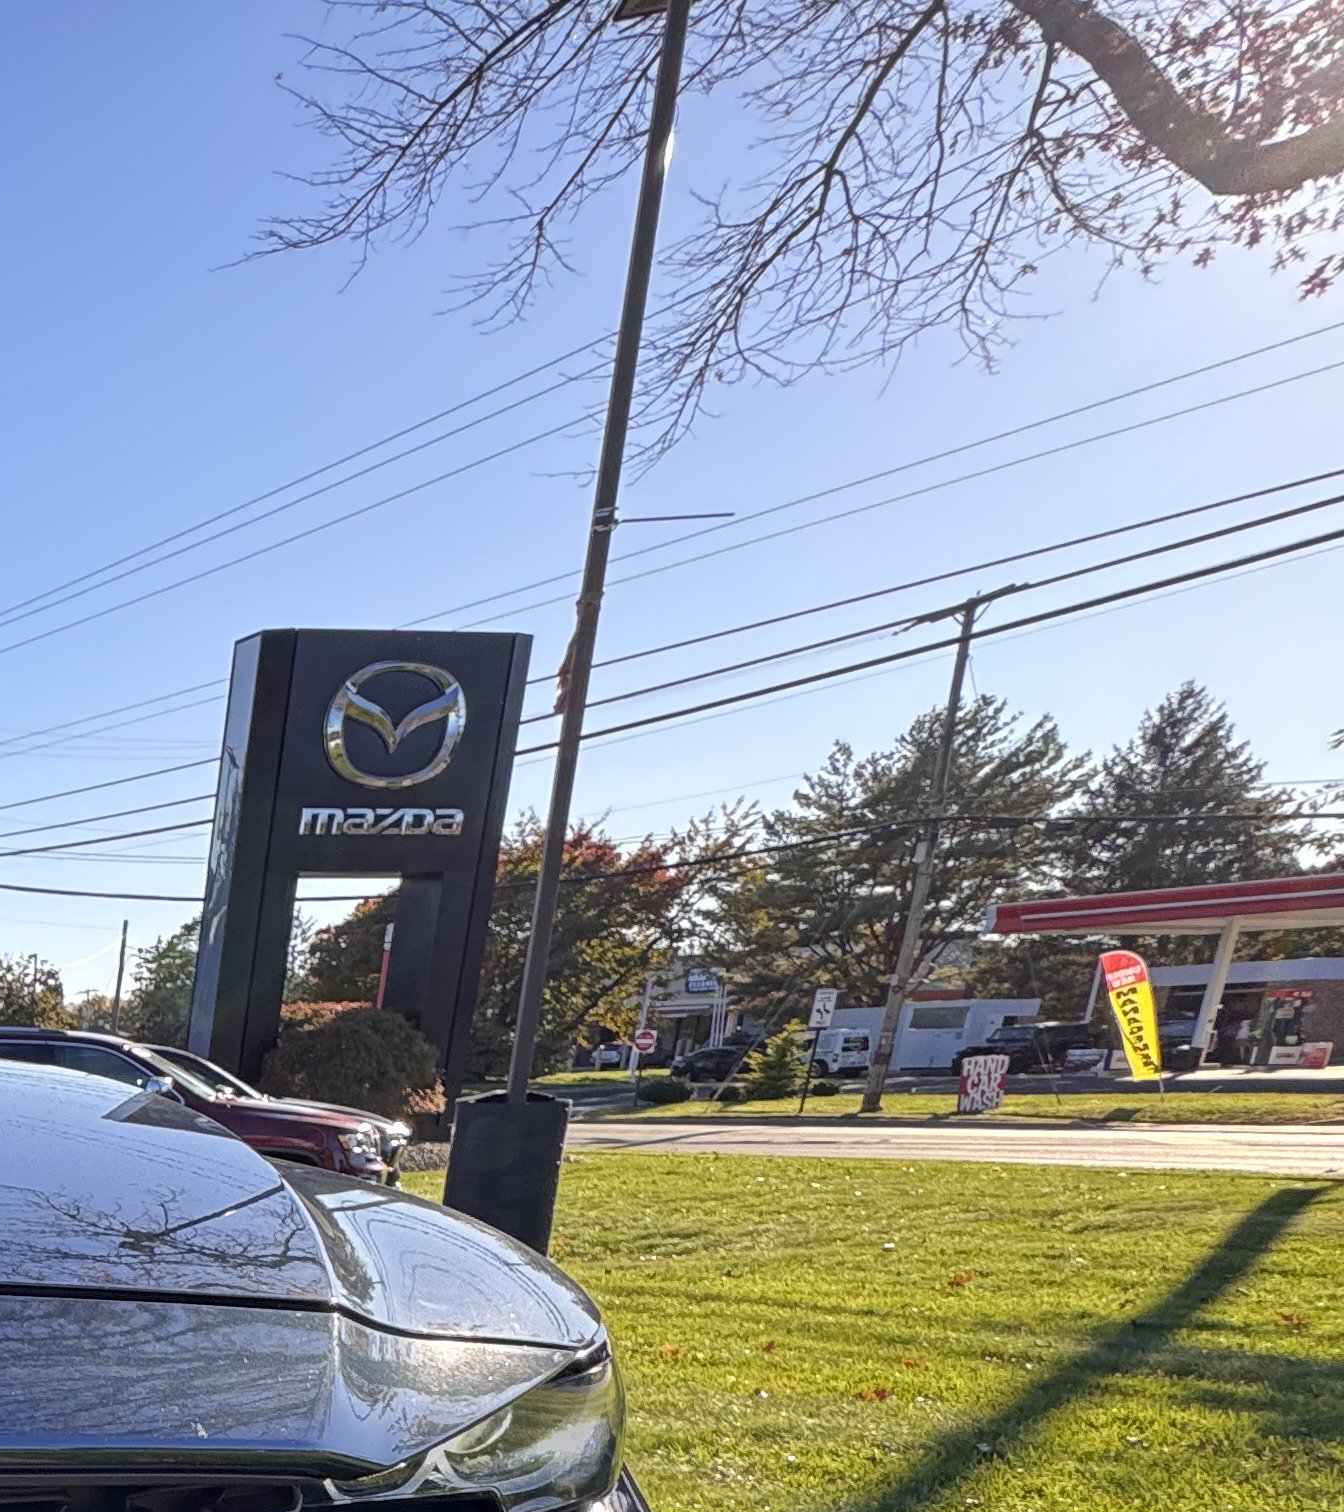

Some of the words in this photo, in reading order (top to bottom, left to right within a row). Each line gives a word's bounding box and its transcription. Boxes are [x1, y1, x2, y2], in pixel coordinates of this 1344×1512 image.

[298, 807, 465, 836] mazda
[962, 1055, 1010, 1077] HAND
[967, 1071, 1002, 1094] CAR
[959, 1089, 1004, 1113] WASH
